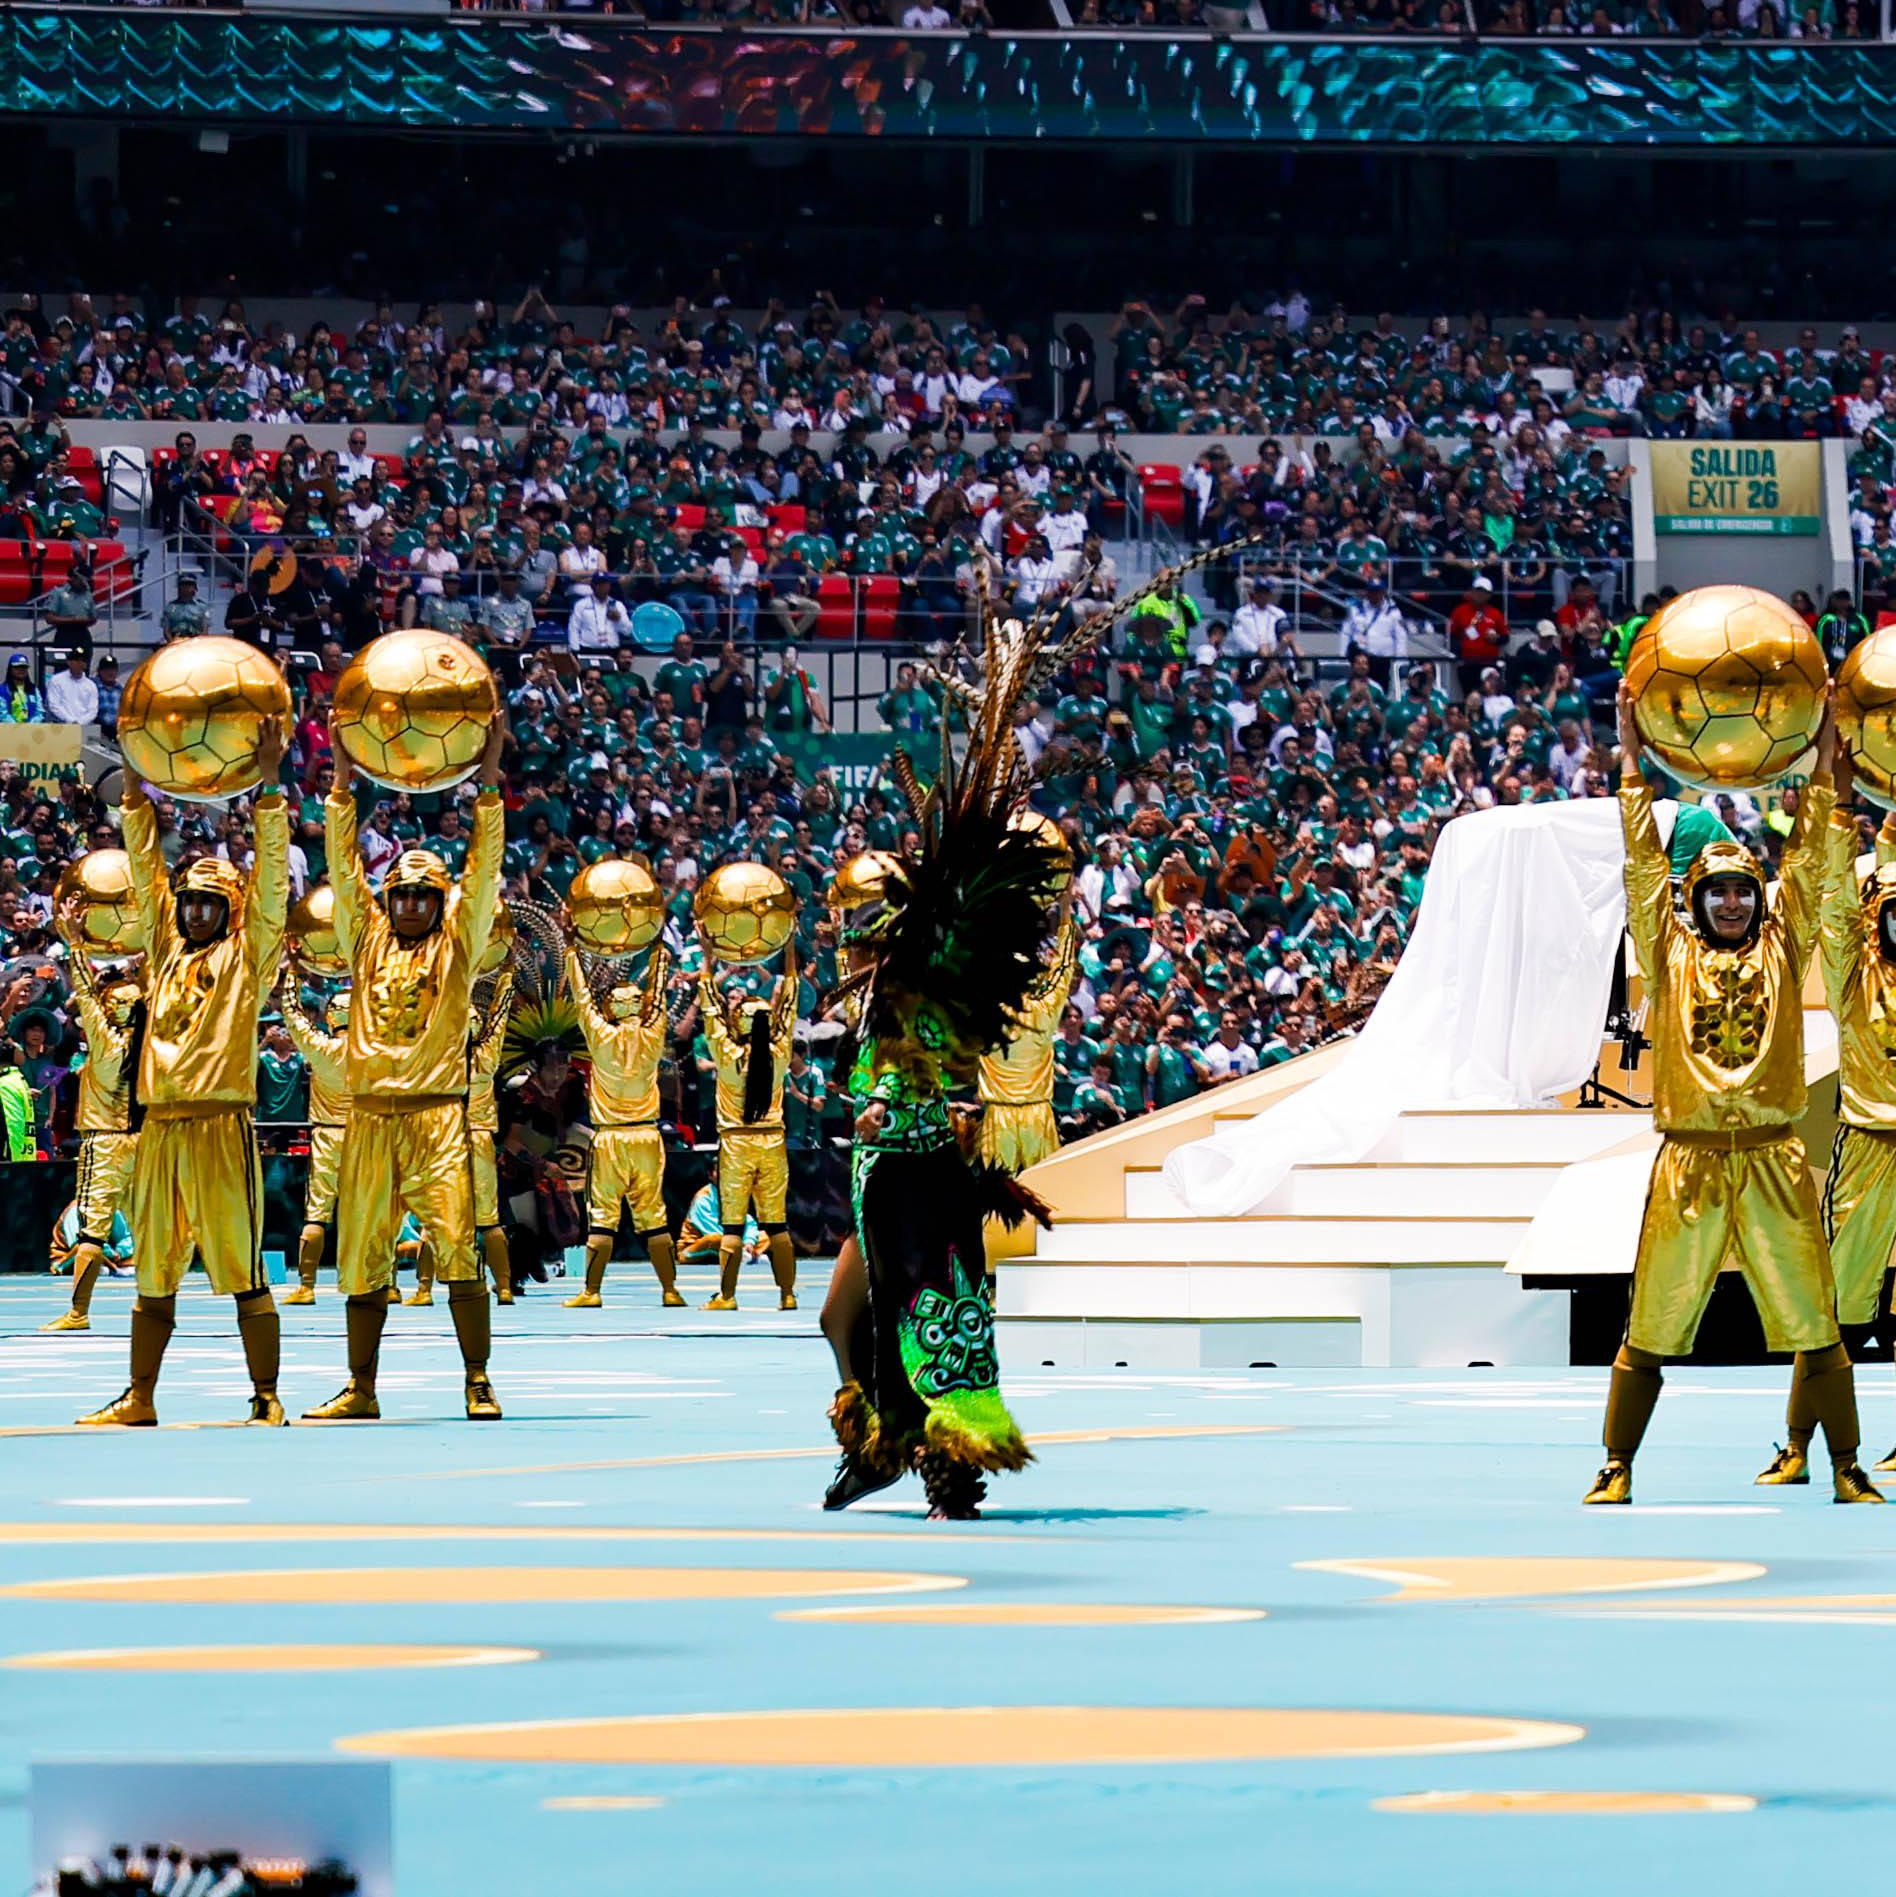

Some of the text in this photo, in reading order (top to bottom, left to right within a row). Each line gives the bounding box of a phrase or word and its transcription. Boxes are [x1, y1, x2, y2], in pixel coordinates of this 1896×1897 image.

[1690, 448, 1777, 477] SALIDA
[1688, 480, 1779, 509] EXIT 26
